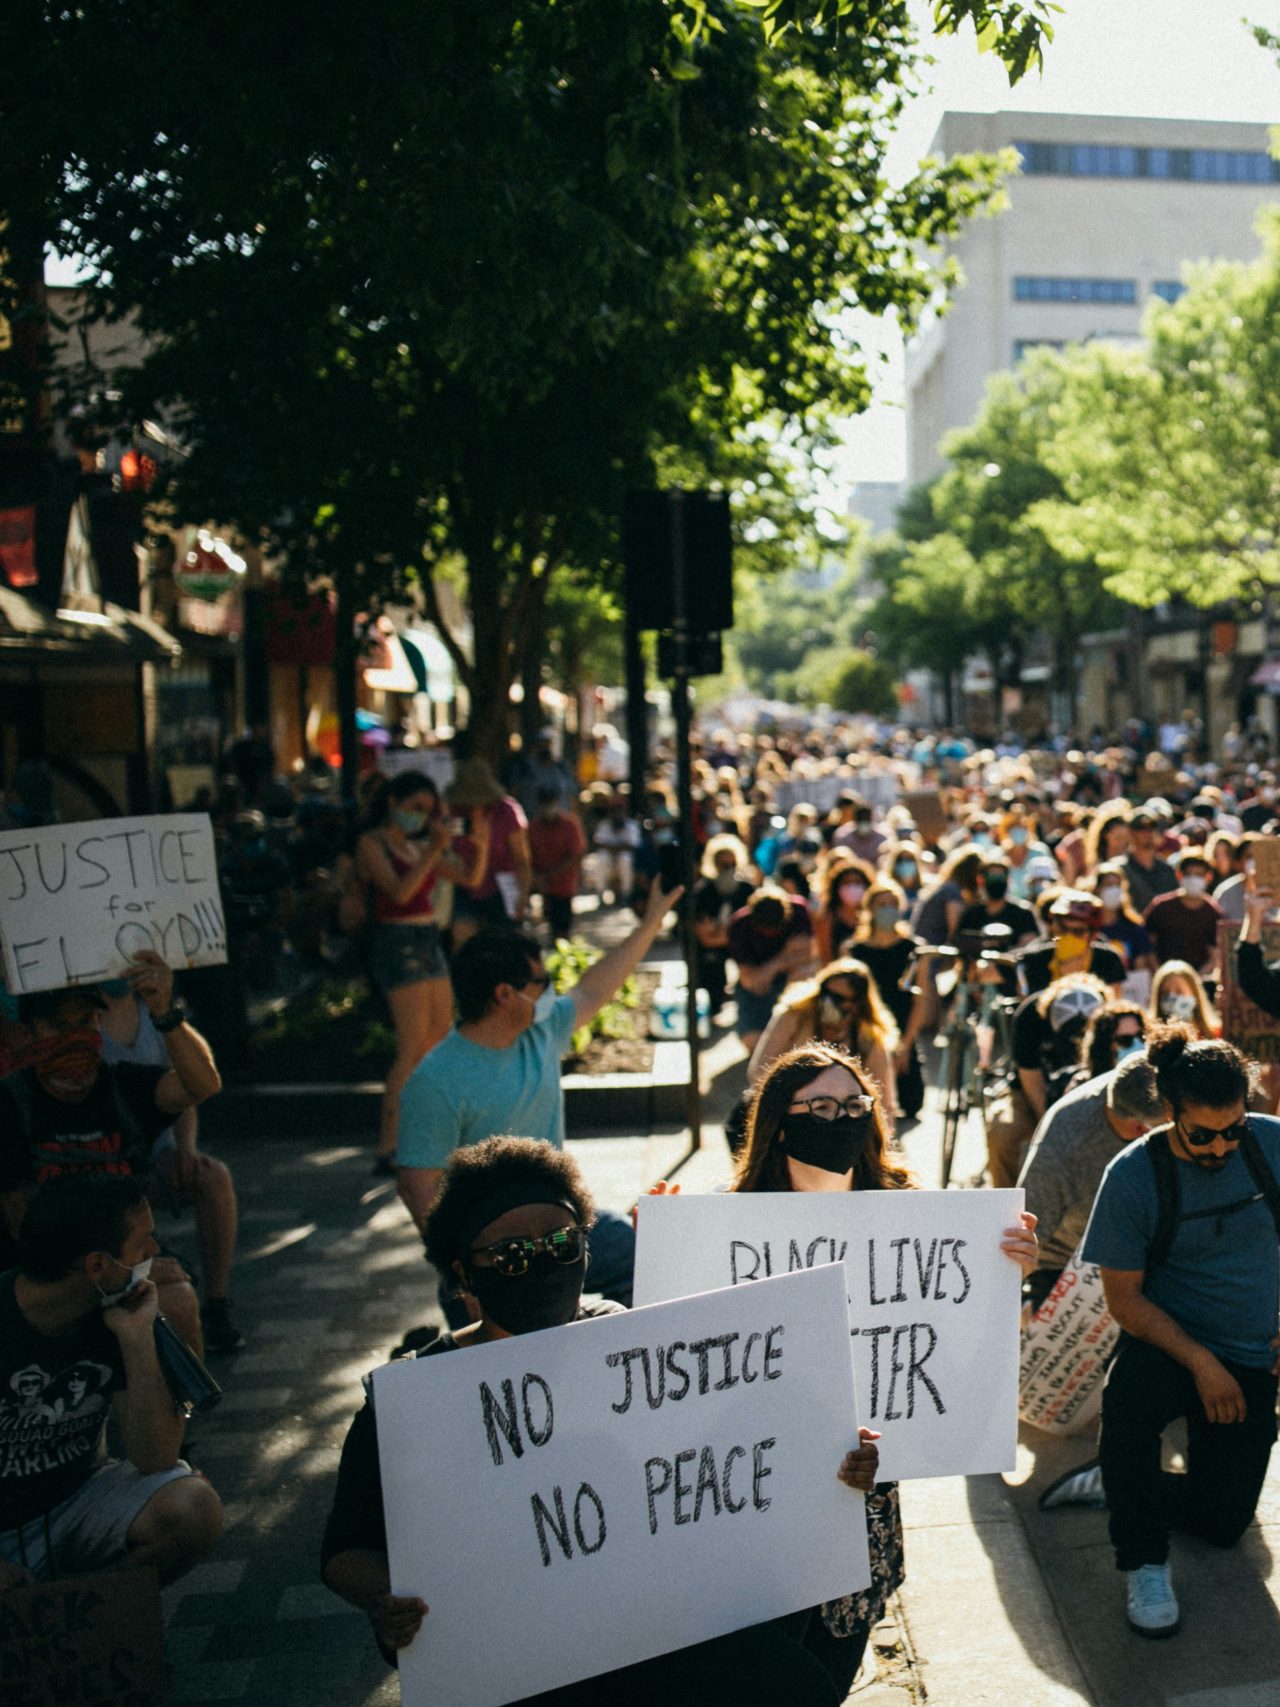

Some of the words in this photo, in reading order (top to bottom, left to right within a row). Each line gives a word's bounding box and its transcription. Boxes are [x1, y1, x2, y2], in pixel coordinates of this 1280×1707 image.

[0, 829, 208, 900] JUSTICE
[104, 894, 156, 919] for
[868, 1237, 971, 1305] LIVES
[1030, 1272, 1077, 1323] TIRED
[1040, 1316, 1091, 1377] IMAGINE
[1046, 1292, 1084, 1341] ABOUT
[479, 1373, 554, 1466] NO
[605, 1325, 785, 1414] JUSTICE
[850, 1322, 947, 1421] TER
[530, 1481, 607, 1567] NO
[644, 1436, 777, 1535] PEACE
